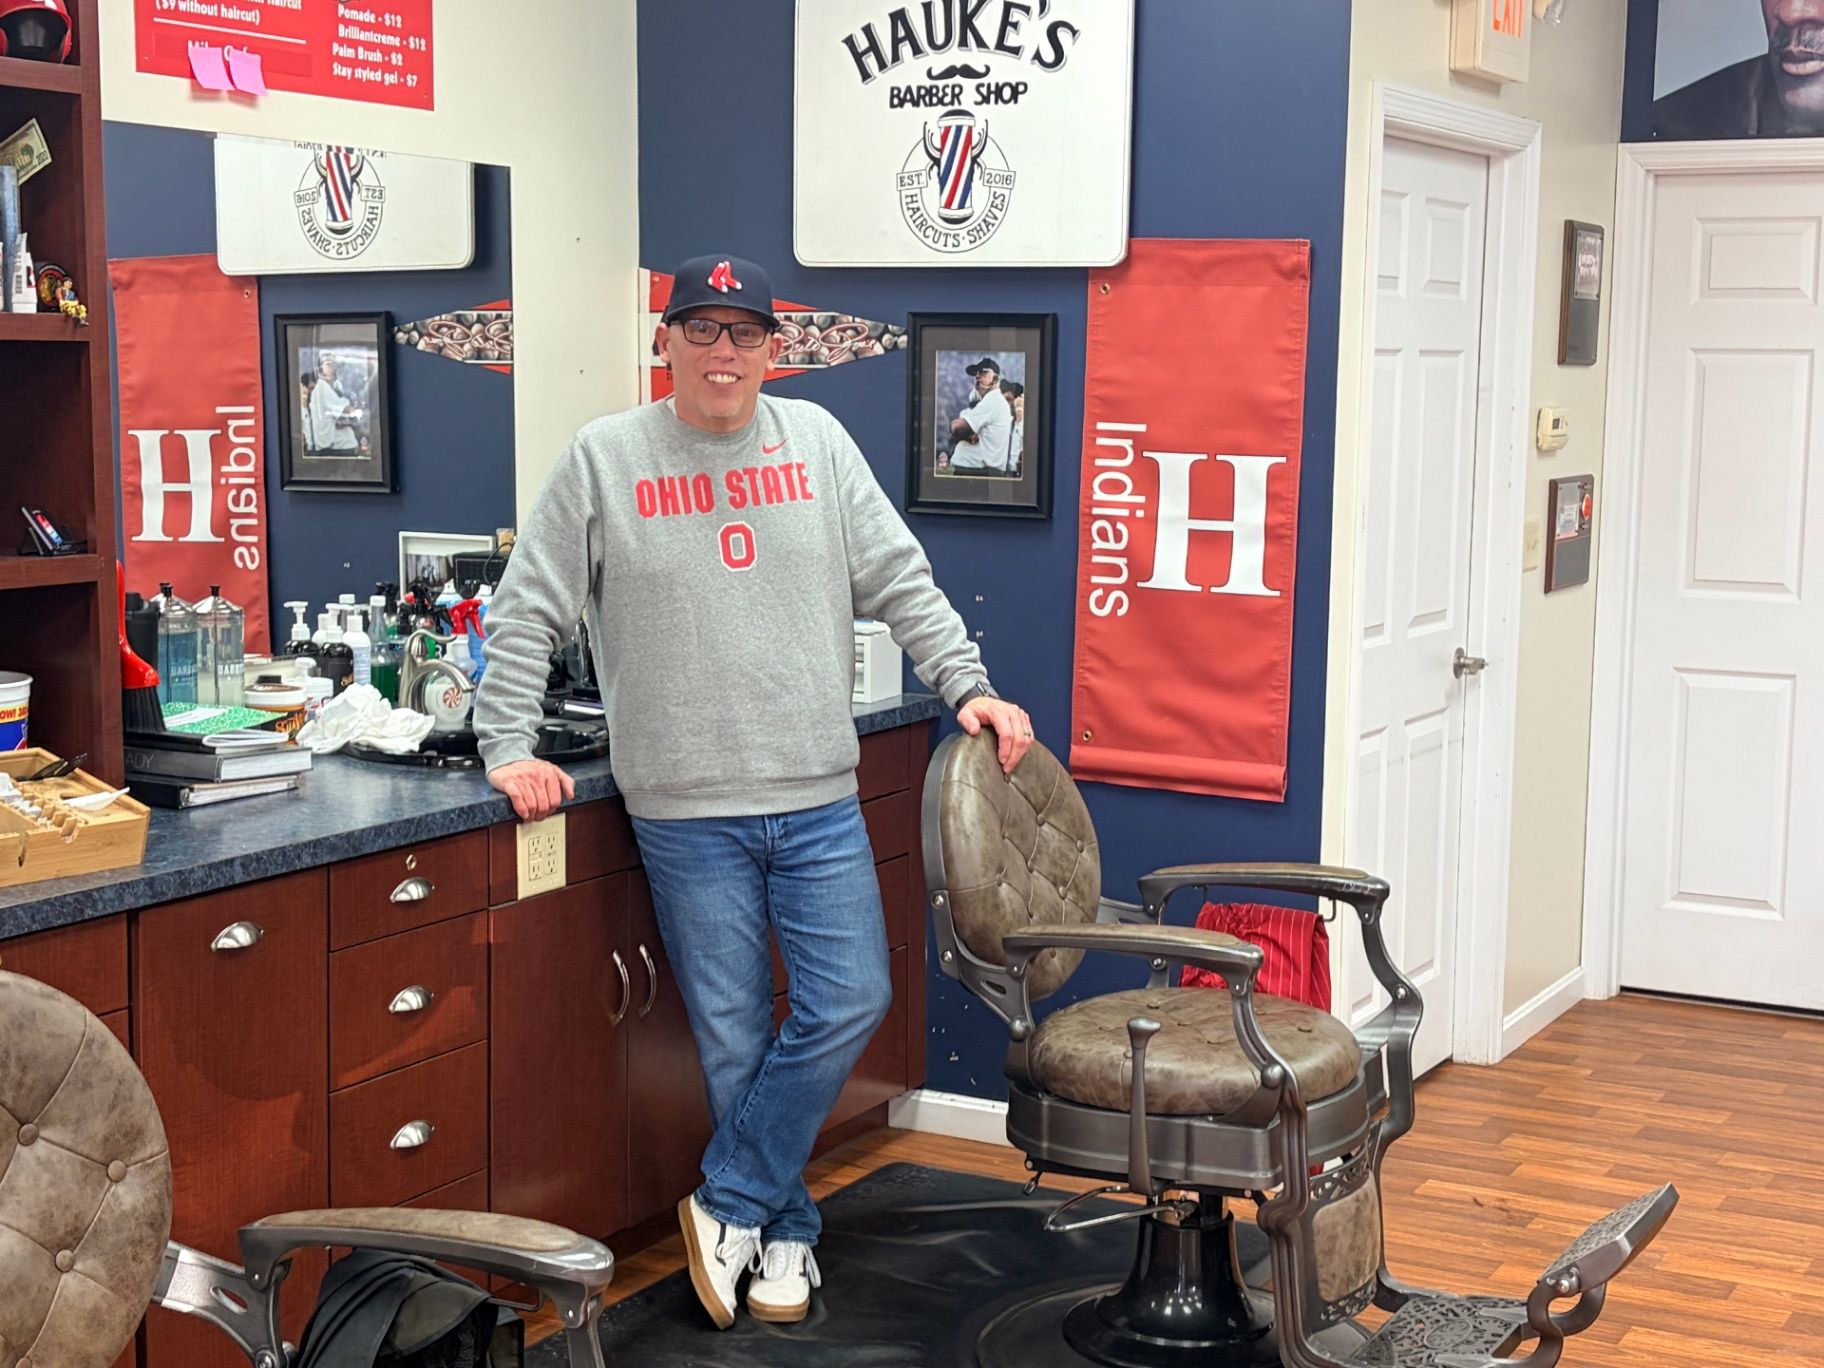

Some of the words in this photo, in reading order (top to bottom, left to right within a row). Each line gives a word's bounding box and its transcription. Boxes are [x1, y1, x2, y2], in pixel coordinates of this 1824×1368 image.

[178, 0, 218, 17] without
[221, 3, 260, 26] haircut)
[337, 3, 376, 23] Pomade
[384, 12, 402, 28] $12
[338, 23, 400, 47] Brilliantcreme
[408, 35, 427, 51] $12
[841, 0, 1080, 84] HAUKE'S
[332, 42, 356, 58] Palm
[357, 46, 383, 62] Brush
[390, 51, 403, 66] $2
[332, 62, 352, 80] Stay
[354, 66, 382, 82] styled
[383, 71, 398, 86] gel
[406, 73, 418, 87] $7
[889, 83, 964, 109] BARBER
[974, 81, 1029, 107] SHOP
[898, 172, 925, 187] EST.
[985, 173, 1013, 186] 2016
[904, 193, 960, 248] HAIRCUTS
[966, 191, 1006, 244] SHAVES
[635, 472, 715, 519] OHIO
[724, 461, 814, 510] STATE
[1088, 421, 1148, 617] Indians
[1136, 450, 1288, 597] H
[717, 521, 758, 572] O
